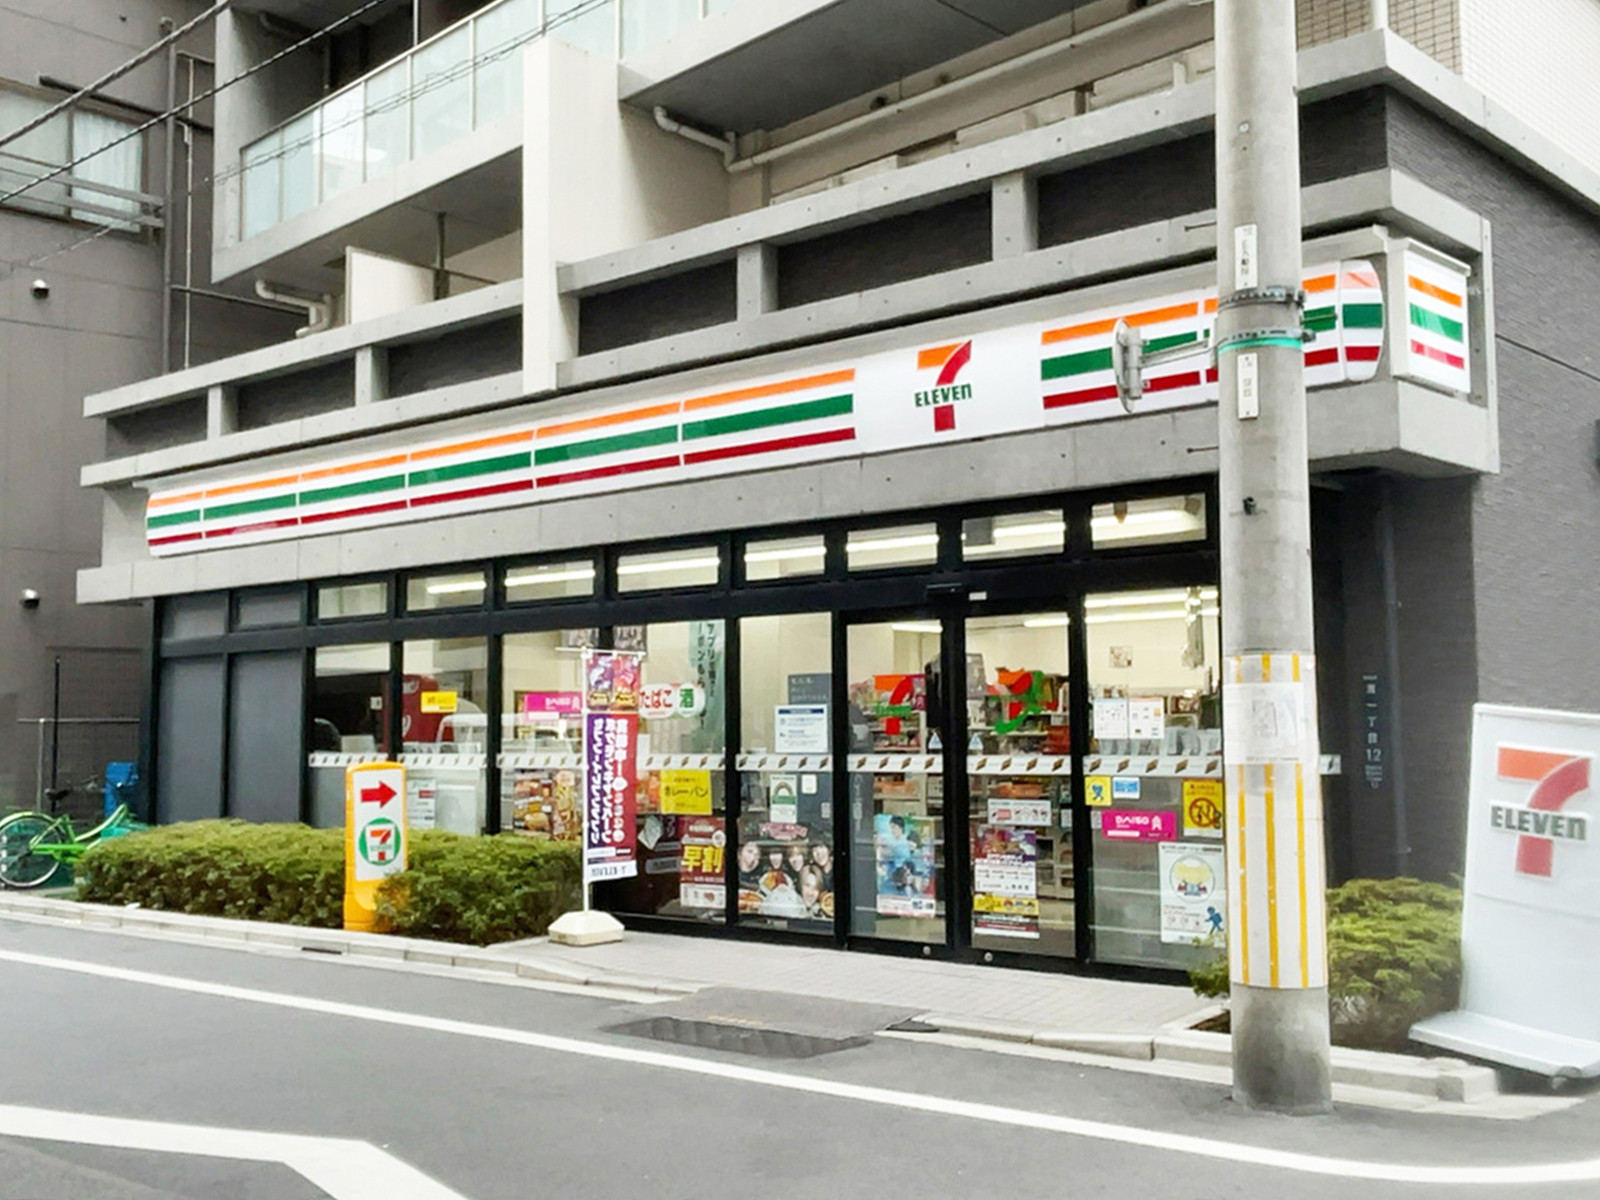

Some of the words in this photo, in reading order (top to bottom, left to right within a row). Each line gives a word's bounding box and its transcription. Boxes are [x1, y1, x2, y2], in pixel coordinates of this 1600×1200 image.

[640, 689, 673, 709] たばこ
[679, 688, 695, 708] 酒
[681, 845, 724, 873] 早割
